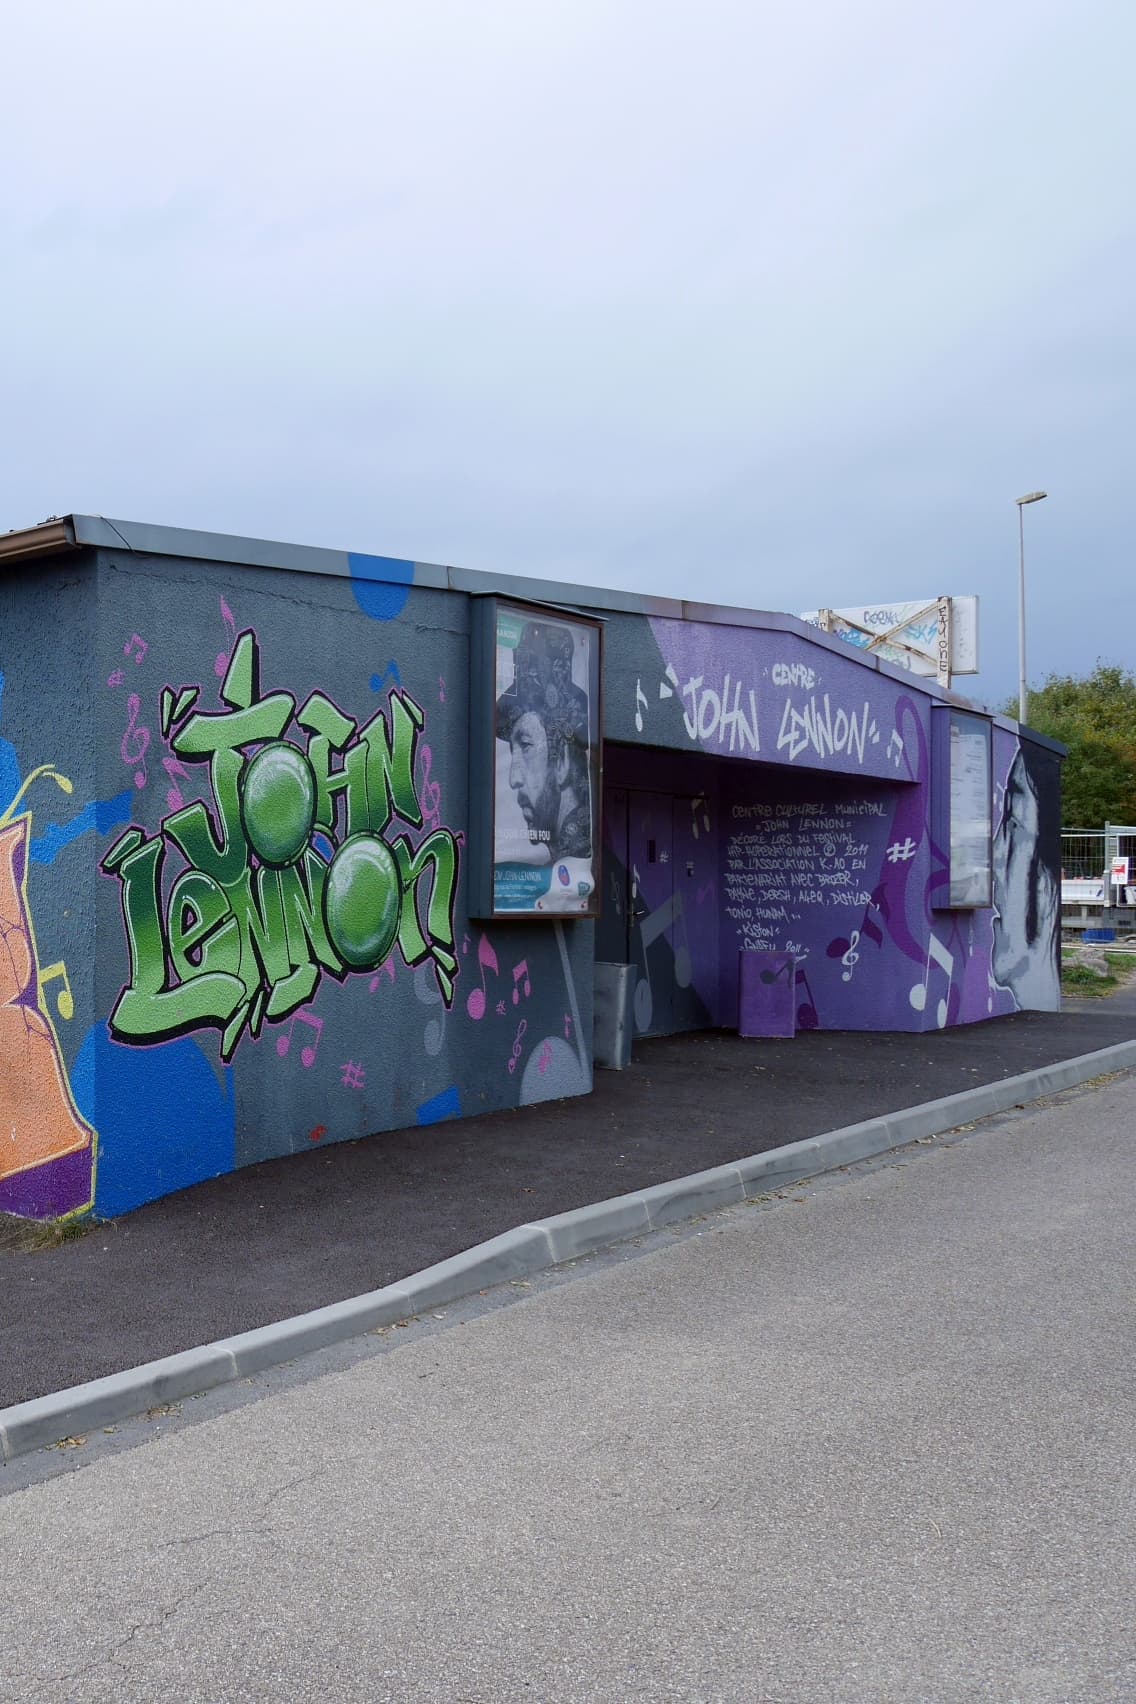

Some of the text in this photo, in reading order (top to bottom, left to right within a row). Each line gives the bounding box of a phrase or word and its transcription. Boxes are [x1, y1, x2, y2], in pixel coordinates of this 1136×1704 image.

[162, 628, 424, 887] JOHN
[538, 830, 551, 841] FOU
[851, 858, 866, 870] EN
